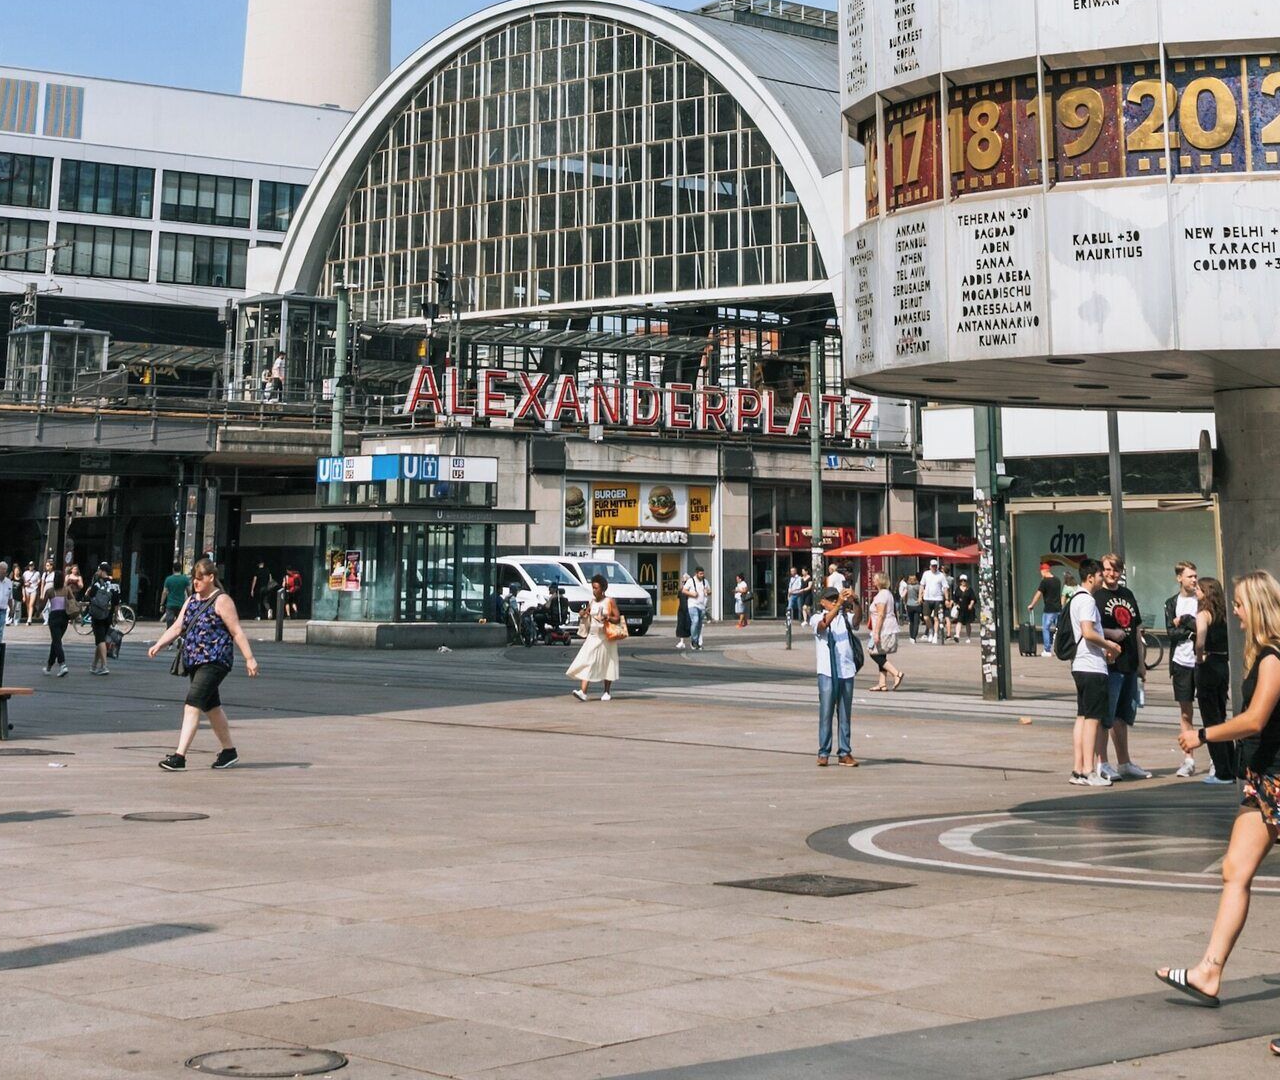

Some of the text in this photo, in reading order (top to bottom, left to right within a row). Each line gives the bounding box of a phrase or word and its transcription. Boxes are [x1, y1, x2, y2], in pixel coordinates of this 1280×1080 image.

[894, 3, 916, 19] MINSK
[898, 18, 913, 32] KIEW
[890, 29, 922, 48] BUKAREST
[896, 46, 916, 60] SOFIA
[1127, 76, 1238, 152] 20
[1026, 86, 1106, 160] 19
[947, 99, 1002, 173] 18
[887, 114, 927, 187] 17
[958, 210, 1005, 226] TEHERAN
[896, 222, 926, 237] ANKARA
[975, 225, 1015, 240] BAGDAD
[1184, 227, 1214, 240] NEW
[1223, 226, 1264, 238] DELHI
[896, 237, 927, 252] ISTANBUL
[1072, 230, 1140, 246] KABUL +30
[982, 242, 1010, 254] ADEN
[1075, 246, 1143, 262] MAURITIUS
[1209, 242, 1276, 254] KARACHI
[900, 253, 922, 266] ATHEN
[976, 256, 1014, 270] SANAA
[1193, 259, 1256, 271] COLOMBO
[896, 266, 926, 280] TEL AVIV
[962, 270, 1031, 287] ADDIS ABEBA
[893, 280, 930, 296] JERUSALEM
[962, 286, 1031, 302] MOGADISCHU
[900, 296, 922, 310] BEIRUT
[962, 301, 1032, 317] DARESSALAM
[894, 310, 930, 326] DAMASKUS
[957, 316, 1040, 333] ANTANANARIVO
[902, 326, 922, 339] KAIRO
[979, 334, 1017, 346] KUWAIT
[896, 340, 930, 356] KAPSTADT
[404, 365, 873, 440] ALEXANDERPLATZ
[320, 458, 330, 480] U
[403, 456, 418, 478] U
[453, 458, 464, 468] U8
[452, 470, 464, 479] U5
[594, 489, 627, 498] BURGER
[594, 500, 637, 509] FÜR MITTE?
[690, 498, 702, 506] ICH
[594, 508, 619, 518] BITTE!
[690, 506, 708, 514] LIEBE
[615, 529, 688, 544] McDonald's
[1050, 525, 1086, 554] dm
